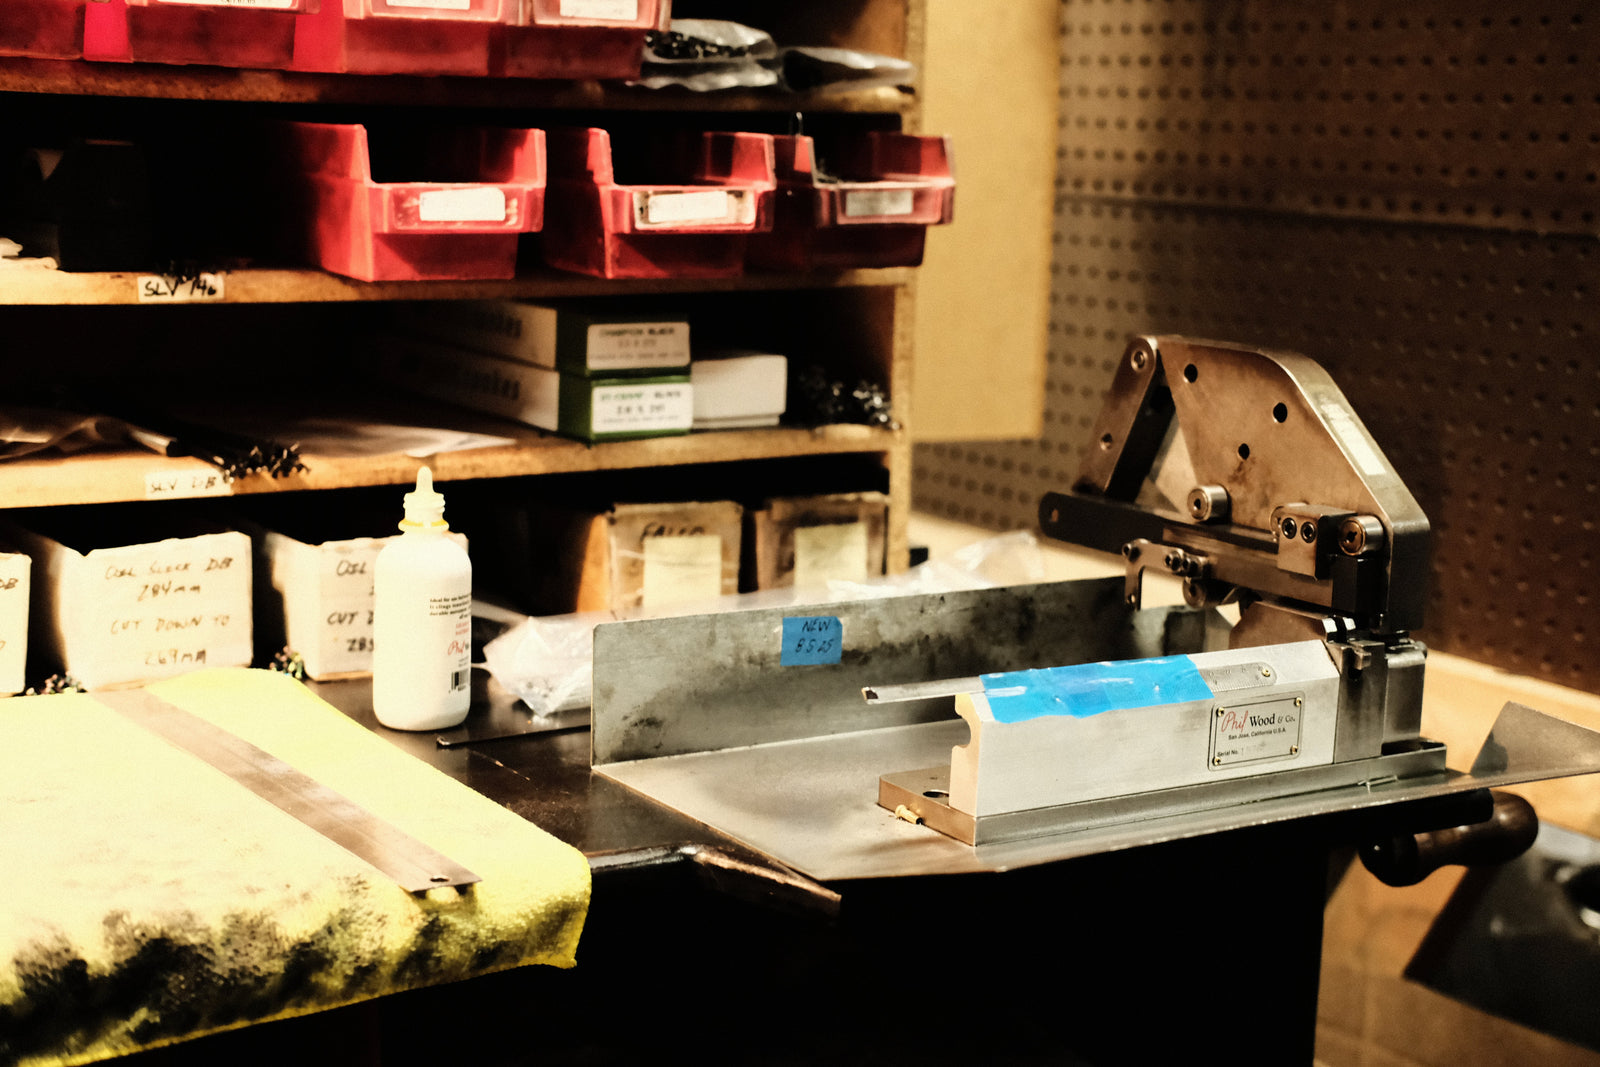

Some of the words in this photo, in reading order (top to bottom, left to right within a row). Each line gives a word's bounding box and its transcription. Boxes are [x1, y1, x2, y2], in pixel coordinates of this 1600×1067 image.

[327, 611, 358, 625] CUT
[802, 618, 831, 632] NEW
[111, 619, 141, 635] CUT
[155, 616, 202, 632] DOWN
[1221, 710, 1249, 733] Phil
[1249, 713, 1276, 727] Wood
[1251, 729, 1273, 738] California
[1217, 750, 1231, 758] Serial
